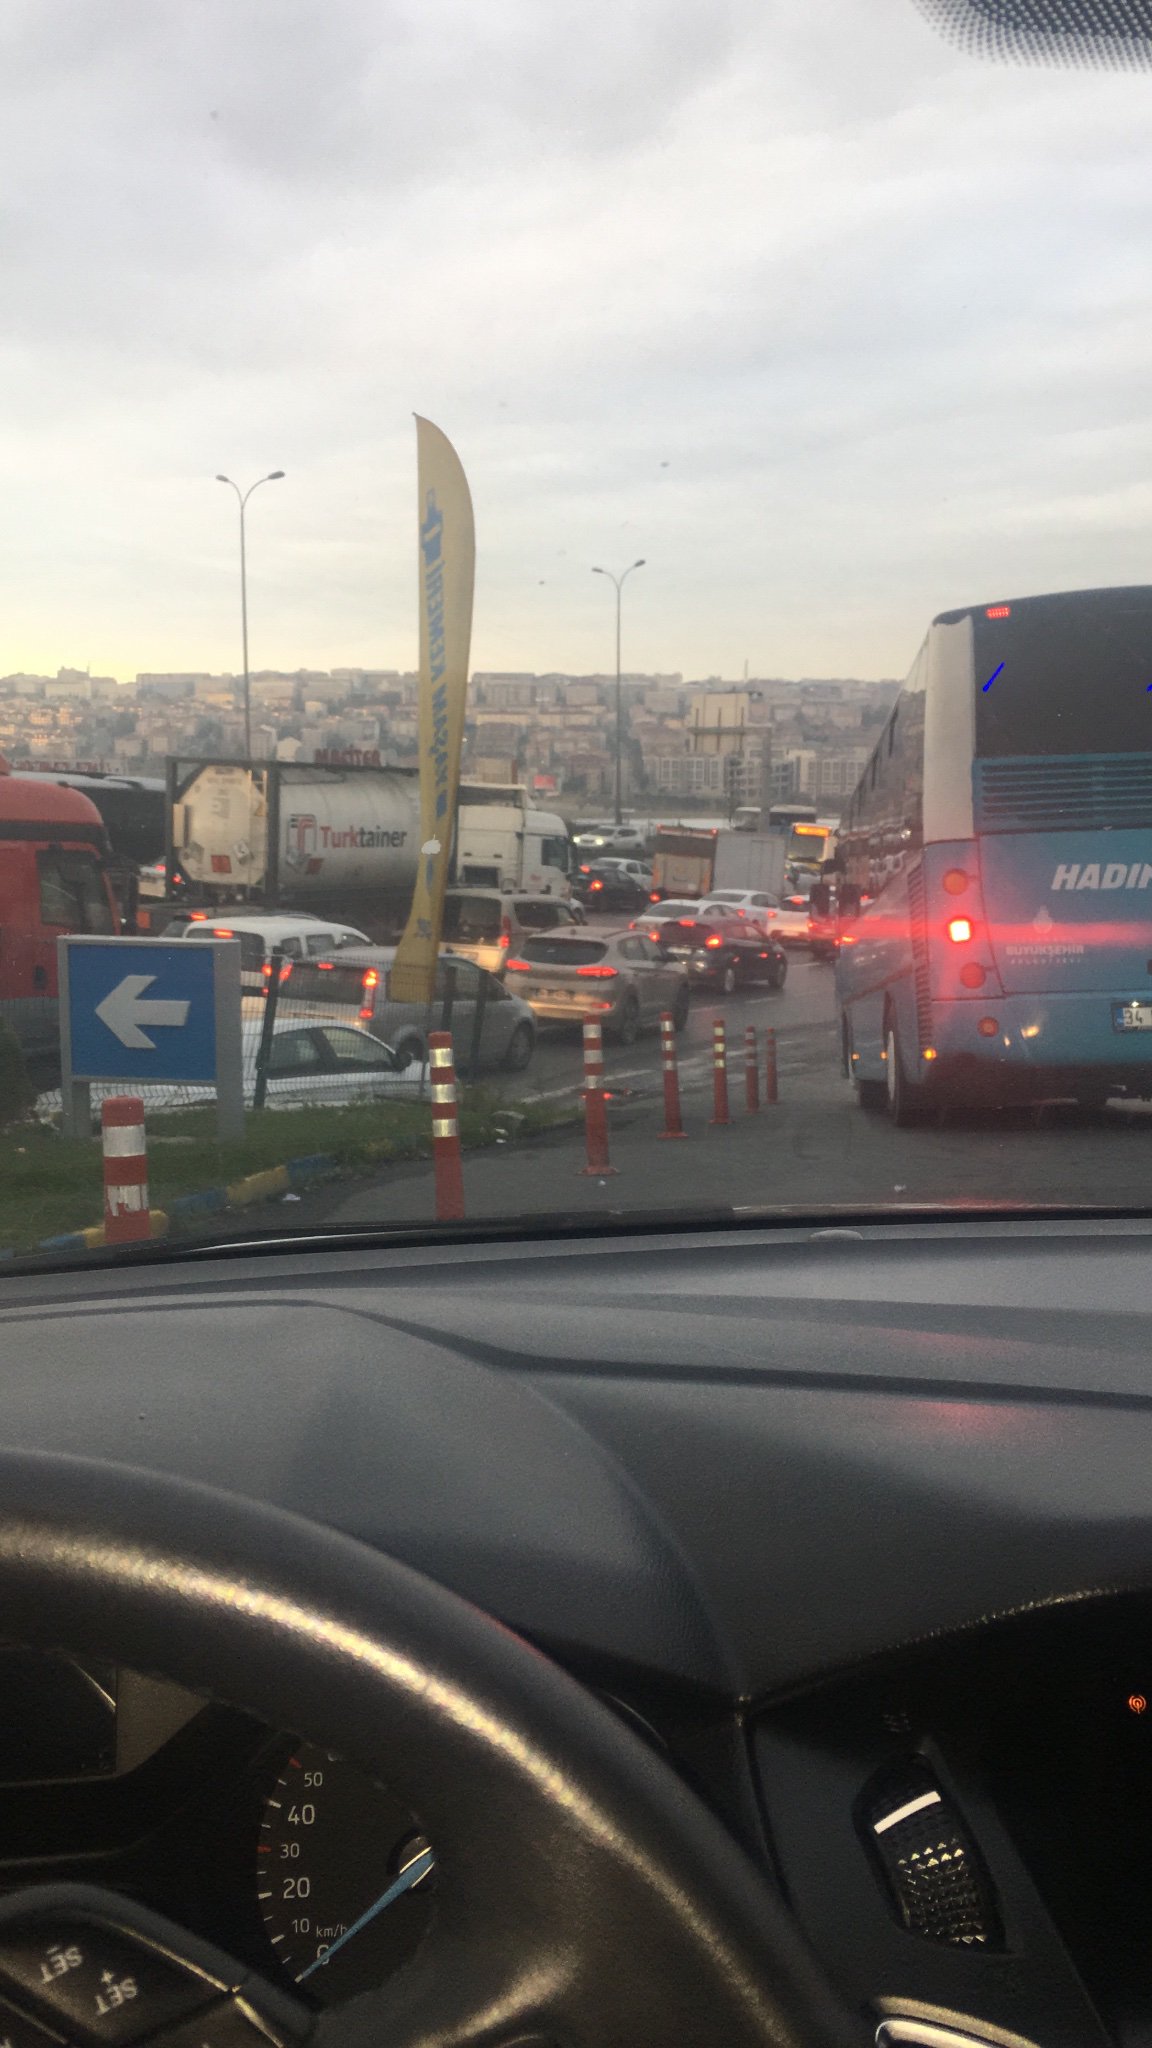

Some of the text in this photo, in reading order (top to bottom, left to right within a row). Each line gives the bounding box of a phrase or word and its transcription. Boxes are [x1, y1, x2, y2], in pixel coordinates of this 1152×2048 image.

[320, 825, 408, 849] Turktainer
[304, 1772, 323, 1788] 50
[287, 1804, 316, 1826] 40
[280, 1843, 300, 1859] 30
[283, 1877, 310, 1899] 20
[292, 1918, 310, 1934] 10
[40, 1946, 83, 1984] SET
[95, 1977, 138, 2016] SET
